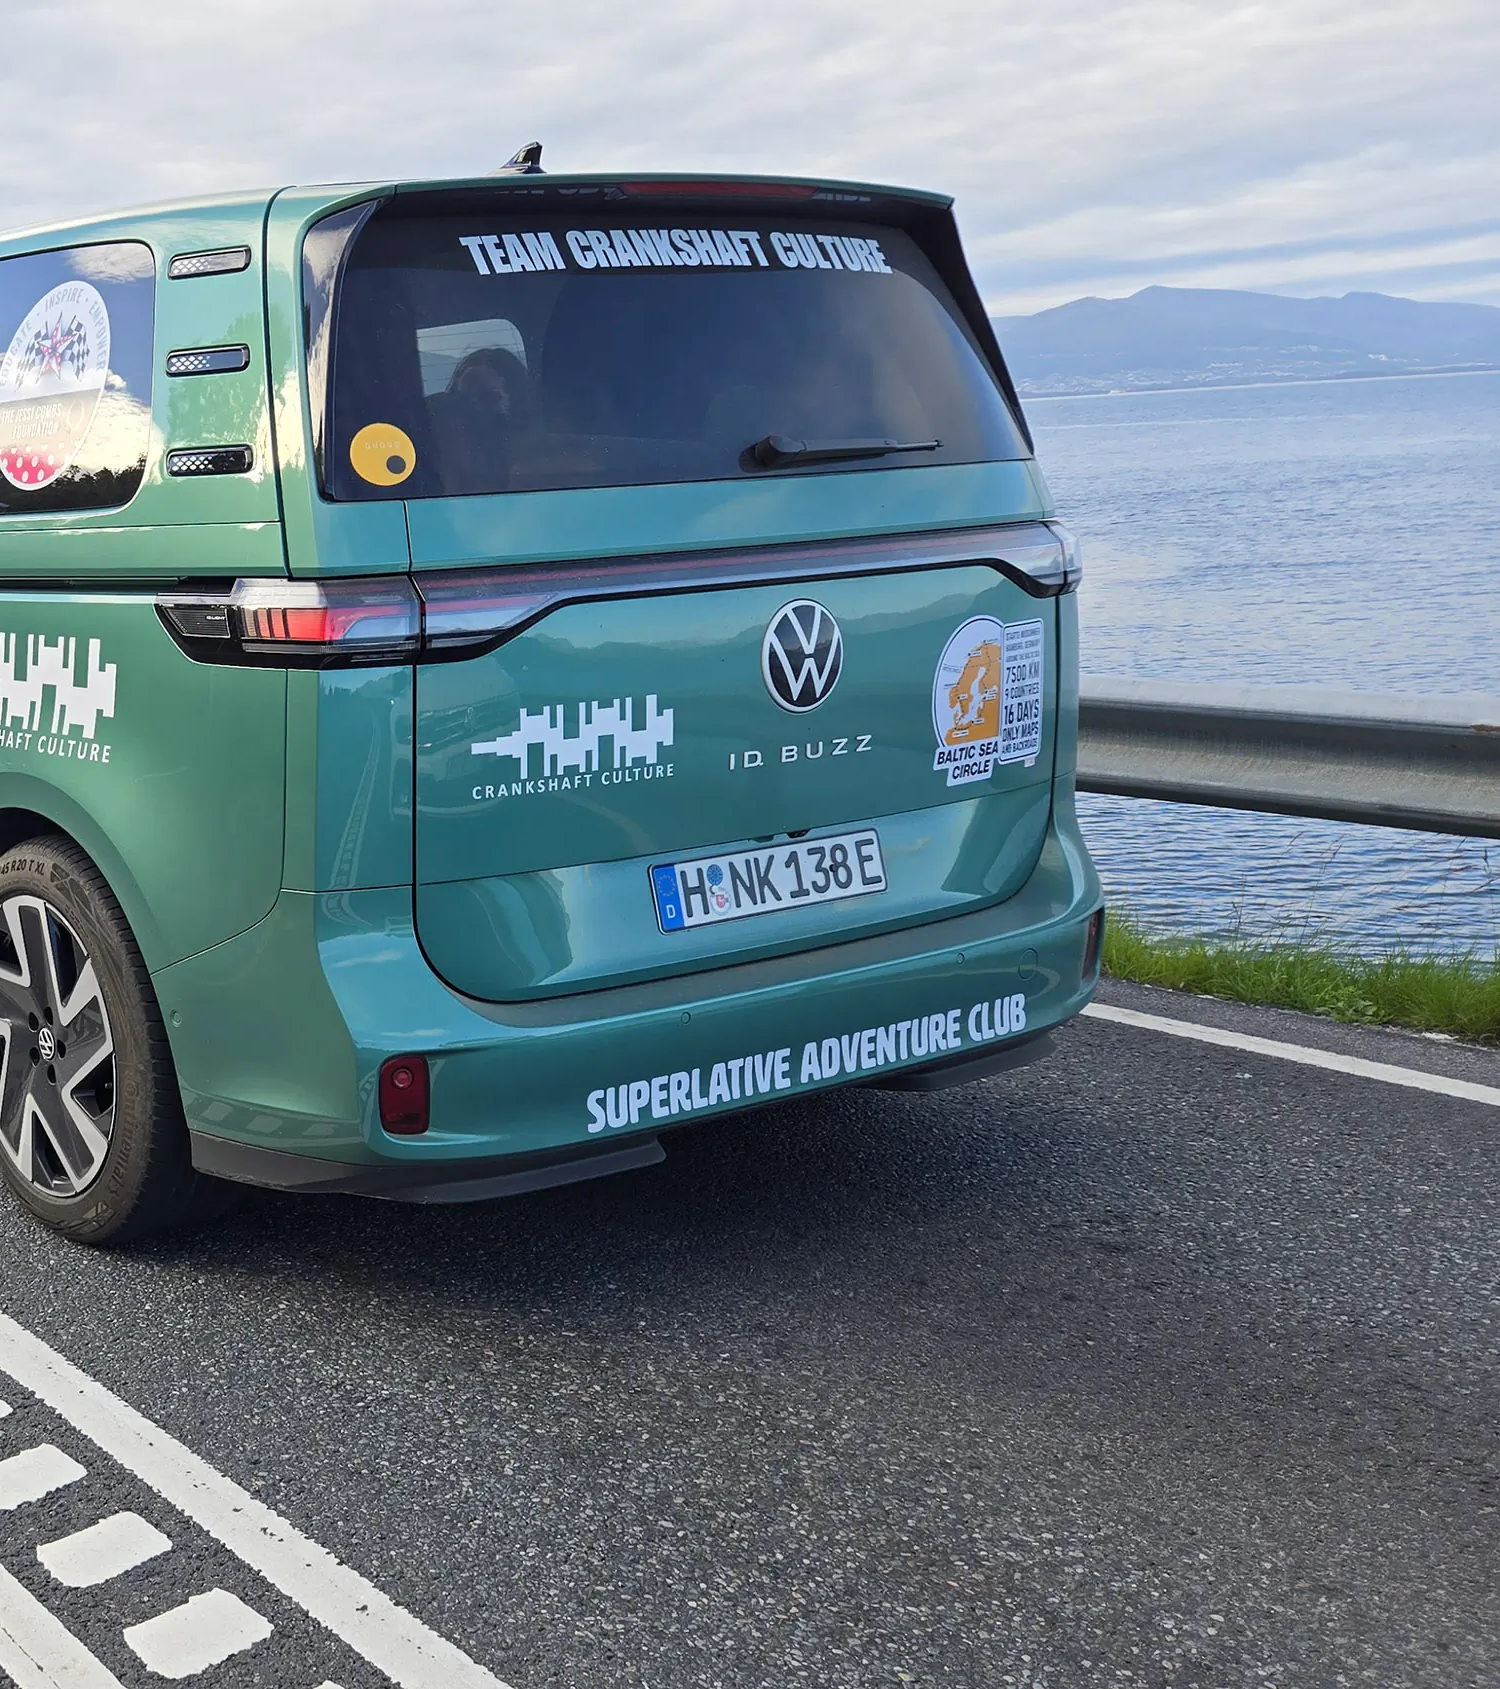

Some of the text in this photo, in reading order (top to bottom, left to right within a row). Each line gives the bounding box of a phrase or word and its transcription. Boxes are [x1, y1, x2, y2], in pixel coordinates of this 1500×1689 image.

[459, 228, 894, 276] TEAM CRANKSHAFT CULTURE
[45, 288, 84, 312] INSPIRE
[89, 299, 106, 371] EMPOWER
[0, 320, 33, 386] EDUCATE
[1006, 661, 1040, 684] 7500 KM
[1004, 698, 1039, 725] 16 DAYS
[1002, 721, 1039, 742] ONLY MAPS
[37, 735, 112, 763] CULTURE
[780, 734, 873, 763] BUZZ
[937, 740, 998, 765] BALTIC SEA
[472, 763, 675, 800] CRANKSHAFT CULTURE
[952, 759, 990, 779] CIRCLE
[680, 867, 710, 918] H
[729, 854, 782, 908] NK
[666, 904, 676, 919] D
[586, 992, 1027, 1134] SUPERLATIVE ADVENTURE CLUB
